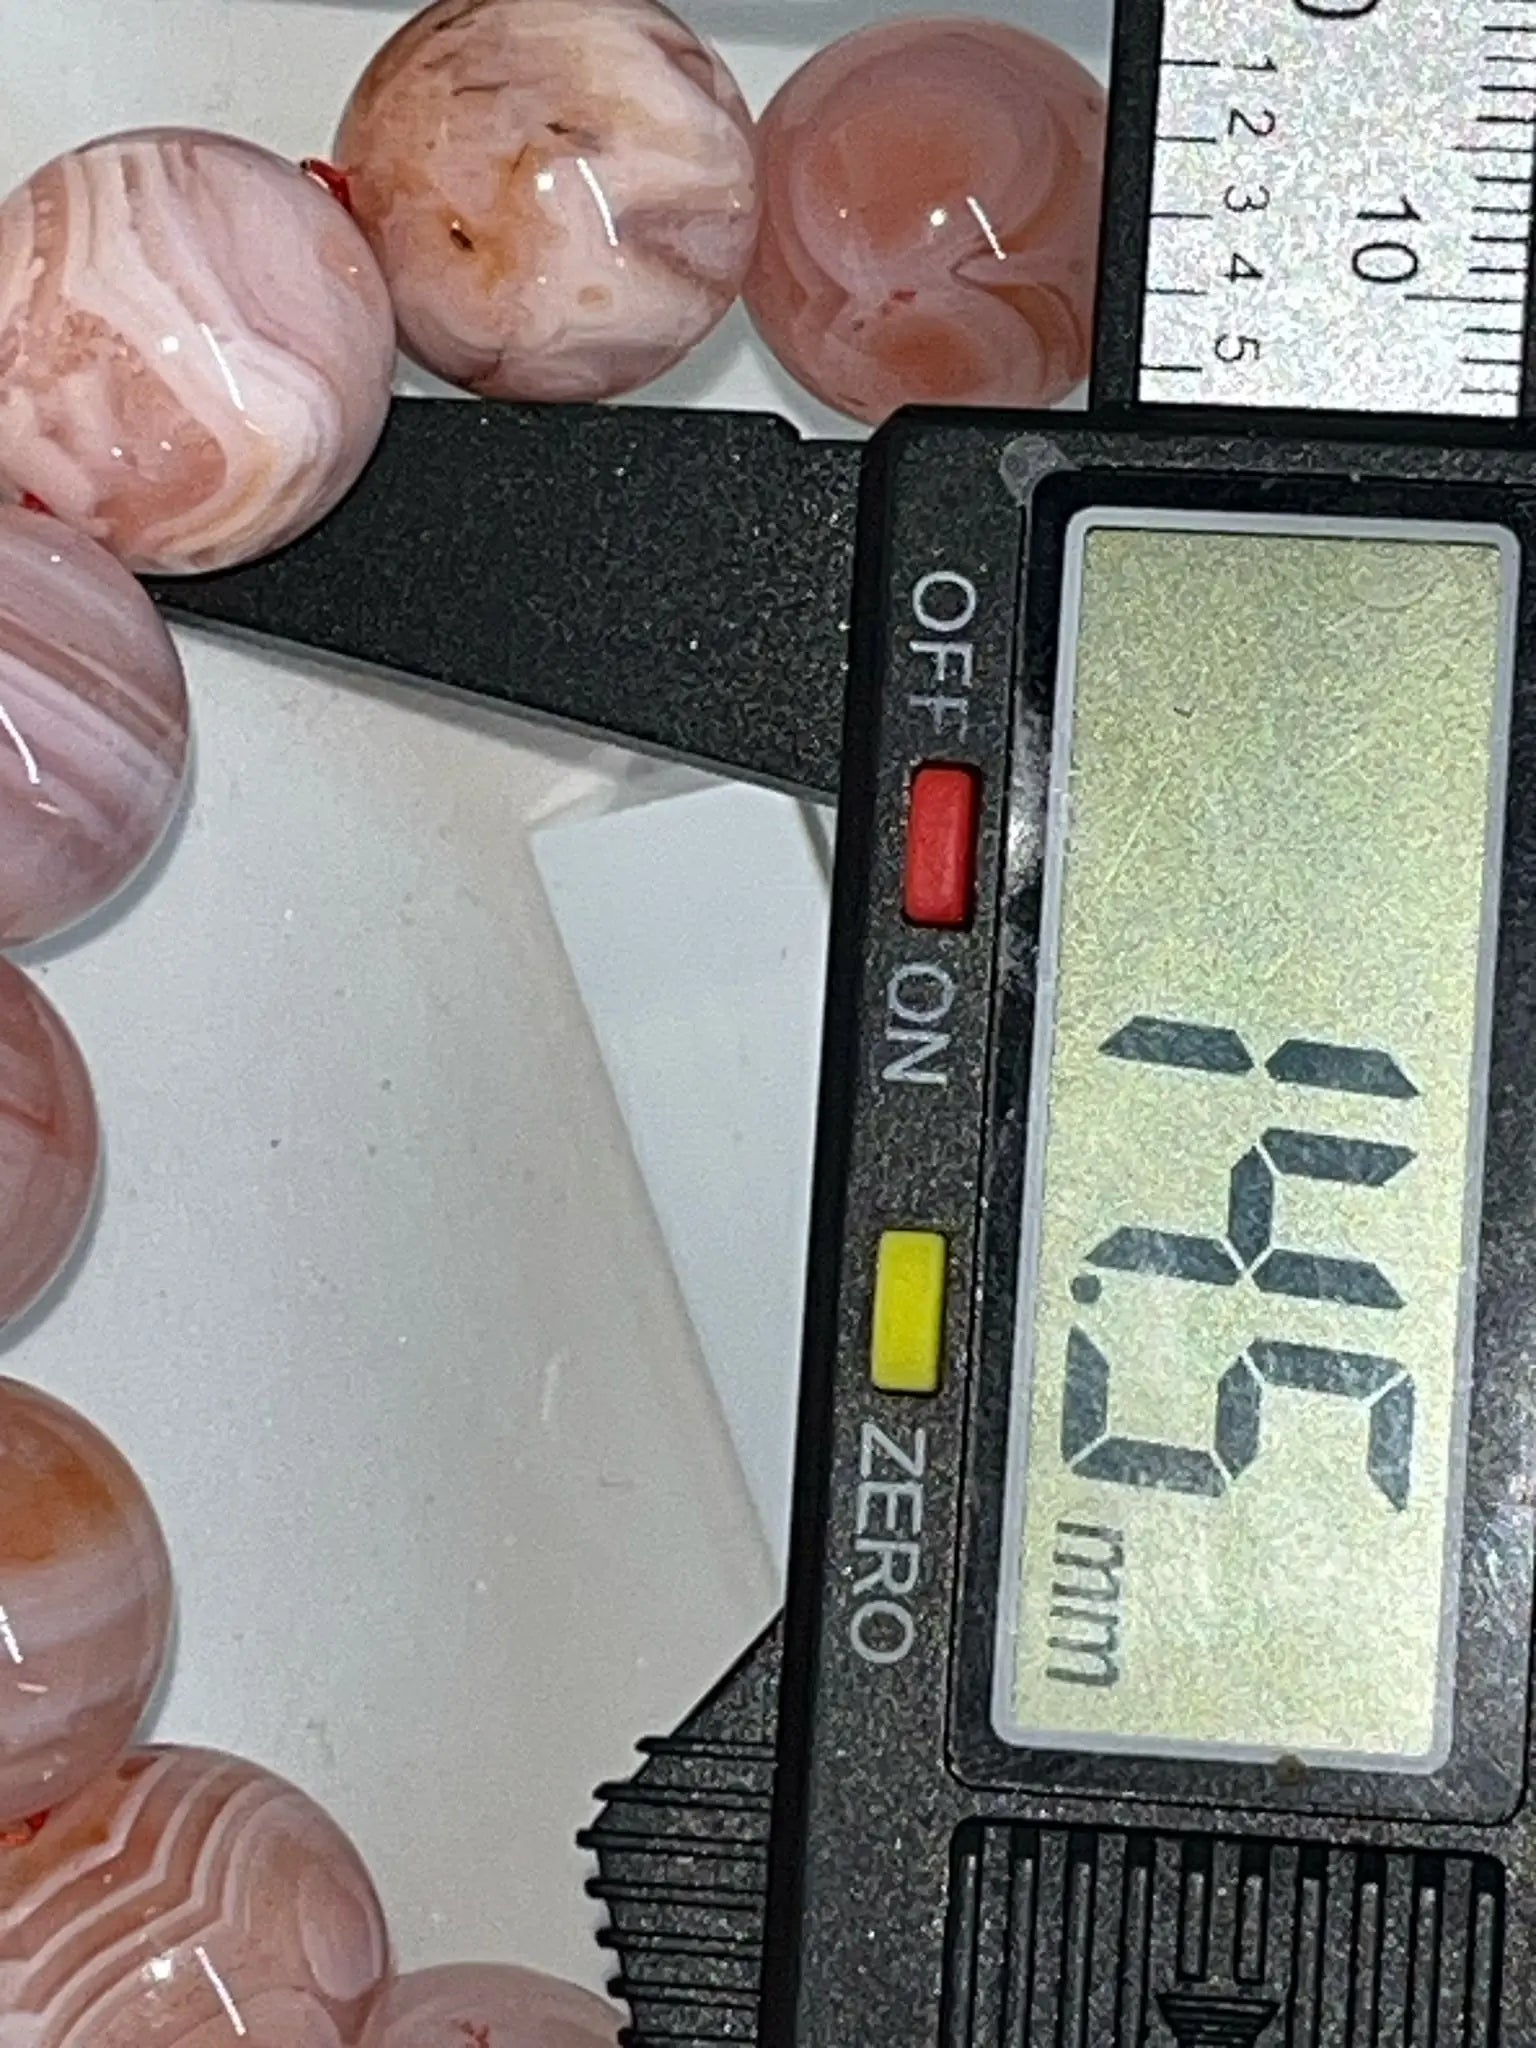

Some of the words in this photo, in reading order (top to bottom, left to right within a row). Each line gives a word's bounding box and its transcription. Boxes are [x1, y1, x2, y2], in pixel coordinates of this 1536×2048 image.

[1232, 54, 1278, 74] 1
[1227, 107, 1276, 138] 2
[1223, 185, 1270, 213] 3
[1352, 195, 1425, 284] 10
[1222, 252, 1264, 284] 4
[1214, 333, 1260, 364] 5
[909, 570, 977, 743] OFF
[881, 962, 955, 1086] ON
[1061, 1015, 1420, 1513] 14.5
[849, 1420, 927, 1665] ZERO
[1045, 1520, 1125, 1688] mm
